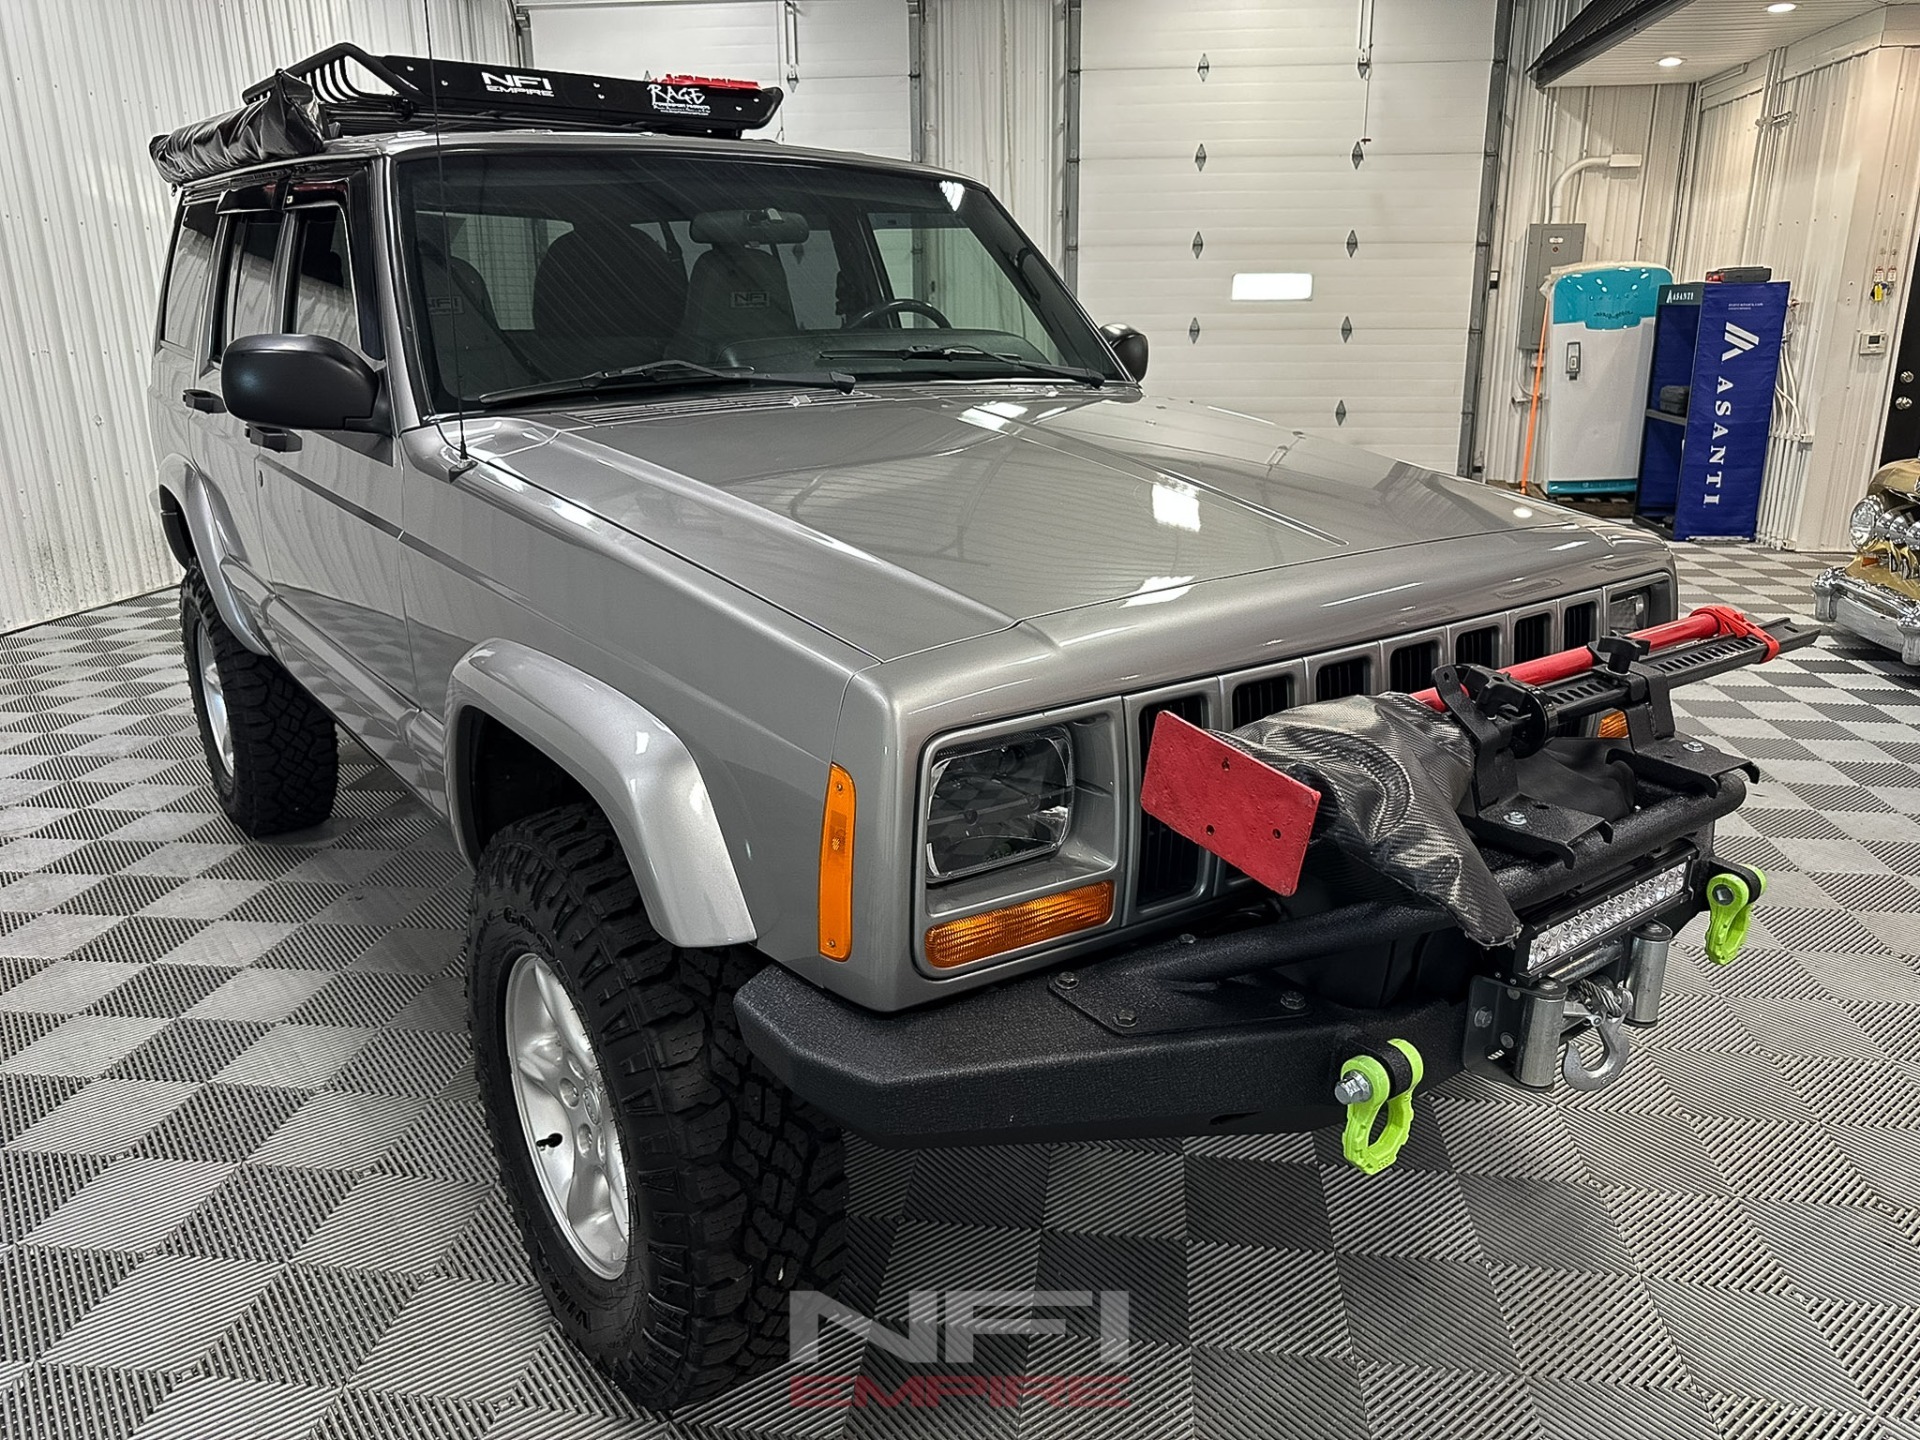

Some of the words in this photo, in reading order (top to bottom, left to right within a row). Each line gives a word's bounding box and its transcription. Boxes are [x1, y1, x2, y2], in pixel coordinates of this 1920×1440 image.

[481, 71, 552, 90] NFI
[486, 84, 555, 97] EMPIRE
[647, 84, 705, 105] RAGE
[735, 292, 767, 302] NFI
[1704, 375, 1734, 505] ASANTI
